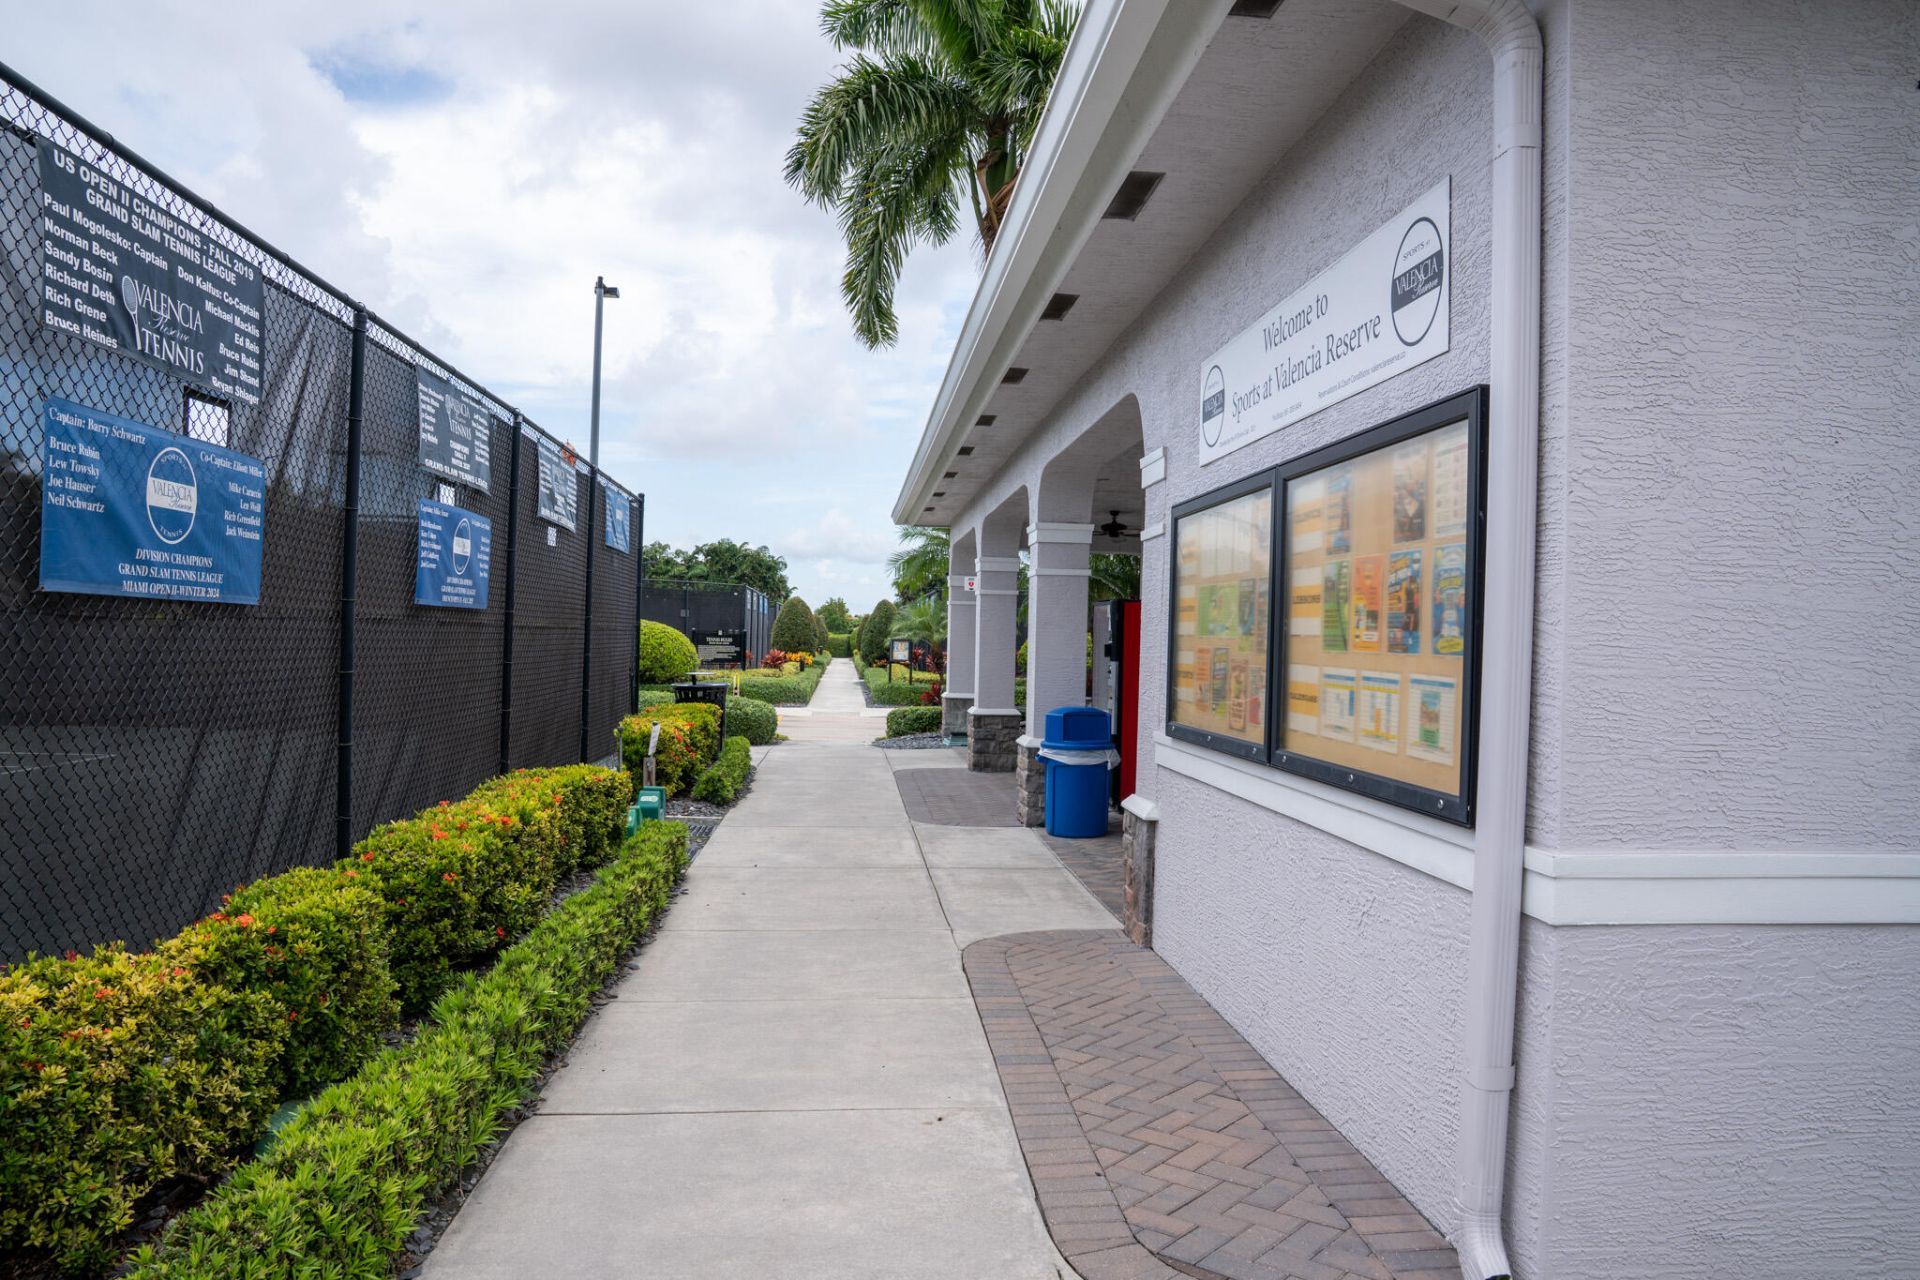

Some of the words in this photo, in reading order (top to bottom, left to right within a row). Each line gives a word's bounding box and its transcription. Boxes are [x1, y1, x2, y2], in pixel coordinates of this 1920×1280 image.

[44, 192, 70, 218] Paul
[73, 207, 131, 251] Mogolesko:
[133, 242, 168, 271] Captain
[53, 148, 76, 175] US
[80, 165, 118, 200] OPEN
[121, 189, 130, 207] II
[133, 198, 201, 249] CHAMPIONS
[209, 243, 232, 268] FALL
[233, 259, 254, 281] 2019
[44, 216, 89, 251] Norman
[92, 241, 119, 266] Beck
[86, 188, 129, 224] GRAND
[131, 214, 161, 243] SLAM
[163, 232, 201, 265] TENNIS
[203, 255, 237, 286] LEAGUE
[1403, 240, 1425, 261] SPORTS
[45, 240, 80, 271] Sandy
[83, 258, 113, 283] Bosin
[1396, 256, 1439, 295] VALENCIA
[45, 262, 89, 294] Richard
[92, 283, 116, 306] Deth
[177, 265, 194, 284] Don
[223, 291, 260, 320] Co-Captain
[45, 285, 71, 309] Rich
[74, 298, 107, 322] Grene
[134, 279, 203, 335] VALENCIA
[205, 299, 233, 324] Michael
[45, 310, 80, 334] Bruce
[83, 323, 118, 349] Heines
[1262, 305, 1313, 353] Welcome
[1315, 293, 1329, 320] to
[141, 327, 204, 374] TENNIS
[219, 342, 240, 361] Bruce
[241, 353, 260, 371] Rubin
[235, 332, 244, 347] Ed
[245, 338, 260, 354] Reis
[212, 376, 234, 394] Bryan
[224, 363, 239, 378] Jim
[240, 369, 260, 388] Shand
[1231, 387, 1261, 423] Sports
[1263, 376, 1273, 398] at
[1274, 345, 1322, 393] Valencia
[1325, 314, 1381, 366] Reserve
[49, 407, 86, 428] Captain:
[88, 418, 110, 438] Barry
[111, 425, 146, 445] Schwartz
[50, 436, 77, 454] Bruce
[48, 473, 63, 488] Joe
[65, 476, 96, 494] Hauser
[49, 455, 67, 470] Lew
[70, 458, 100, 479] Towsky
[48, 491, 65, 507] Neil
[66, 495, 105, 513] Schwartz
[153, 480, 192, 503] VALENCIA
[118, 562, 149, 577] GRAND
[149, 566, 170, 580] SLAM
[170, 568, 197, 583] TENNIS
[197, 571, 224, 585] LEAGUE
[135, 548, 170, 563] DIVISION
[170, 553, 213, 568] CHAMPIONS
[122, 580, 149, 594] MIAMI
[149, 582, 171, 596] OPEN
